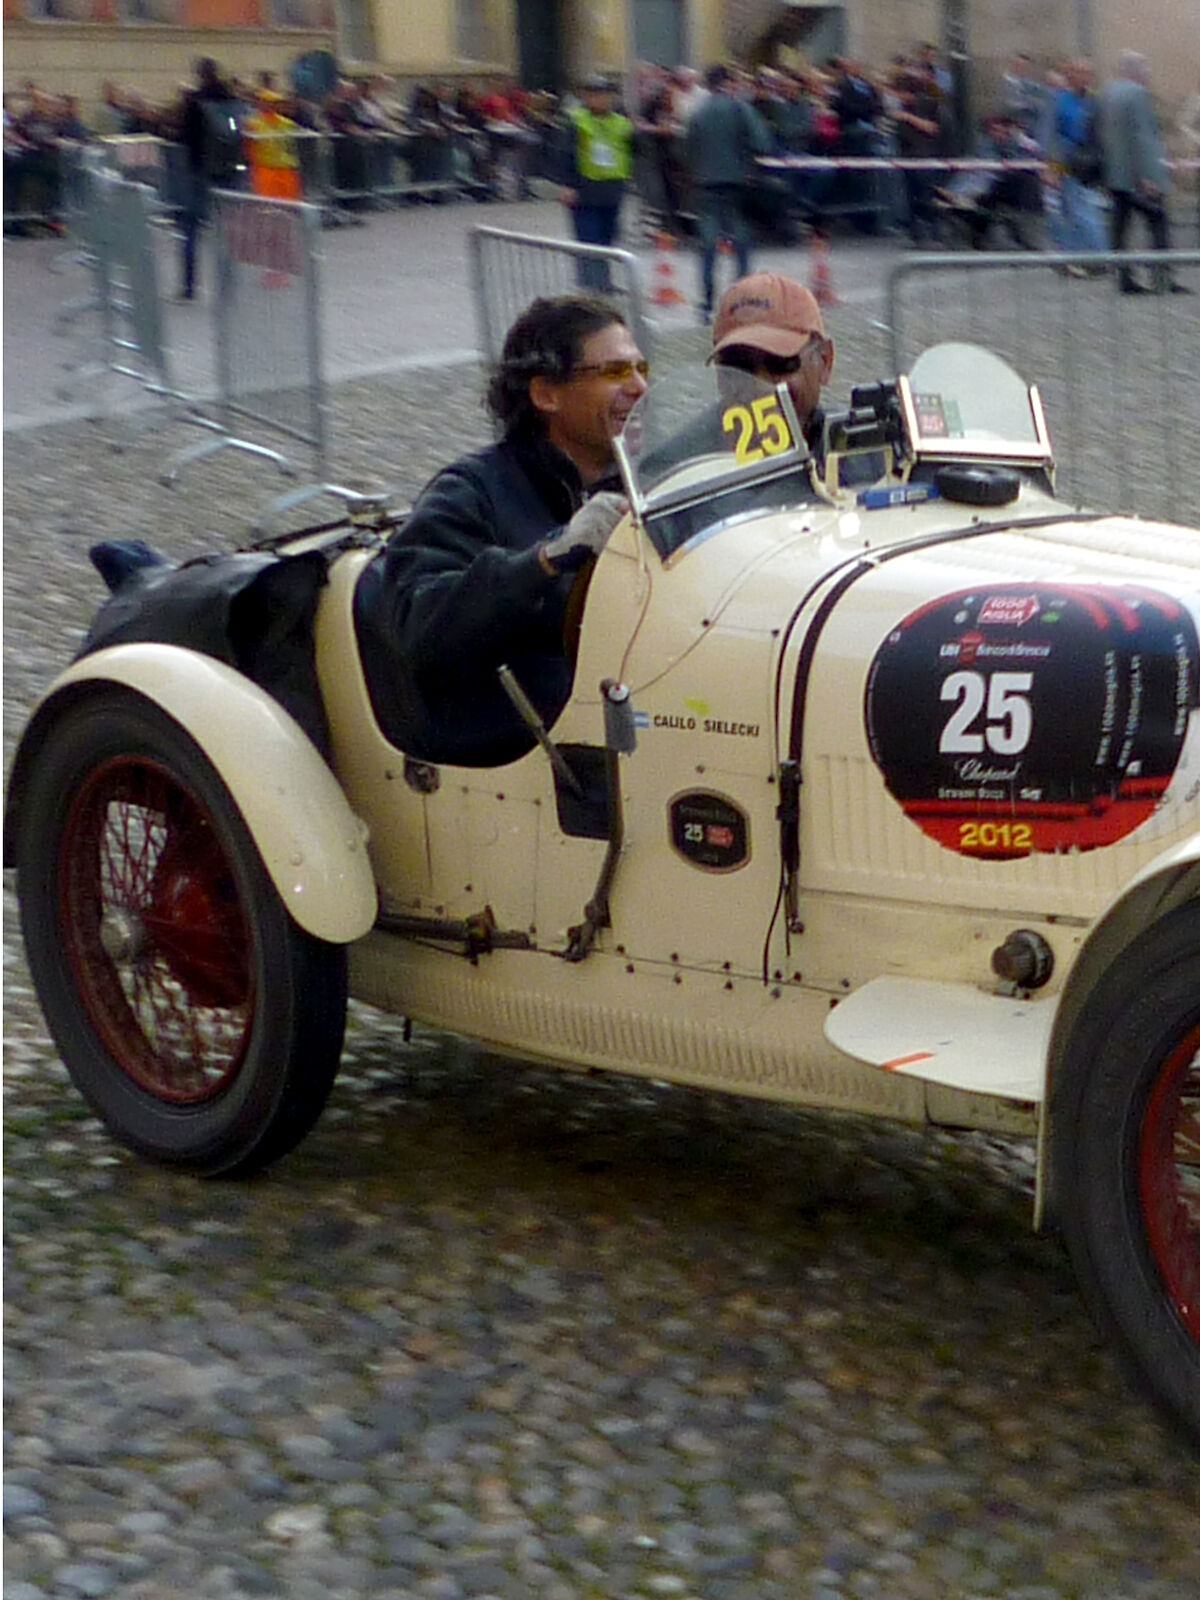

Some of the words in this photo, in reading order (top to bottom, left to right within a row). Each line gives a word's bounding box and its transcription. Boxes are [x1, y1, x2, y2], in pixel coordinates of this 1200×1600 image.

[722, 395, 792, 465] 25
[653, 715, 697, 731] CALILO
[703, 719, 760, 738] SIELECKI
[938, 671, 1034, 756] 25
[684, 824, 703, 842] 25
[959, 821, 1034, 848] 2012
